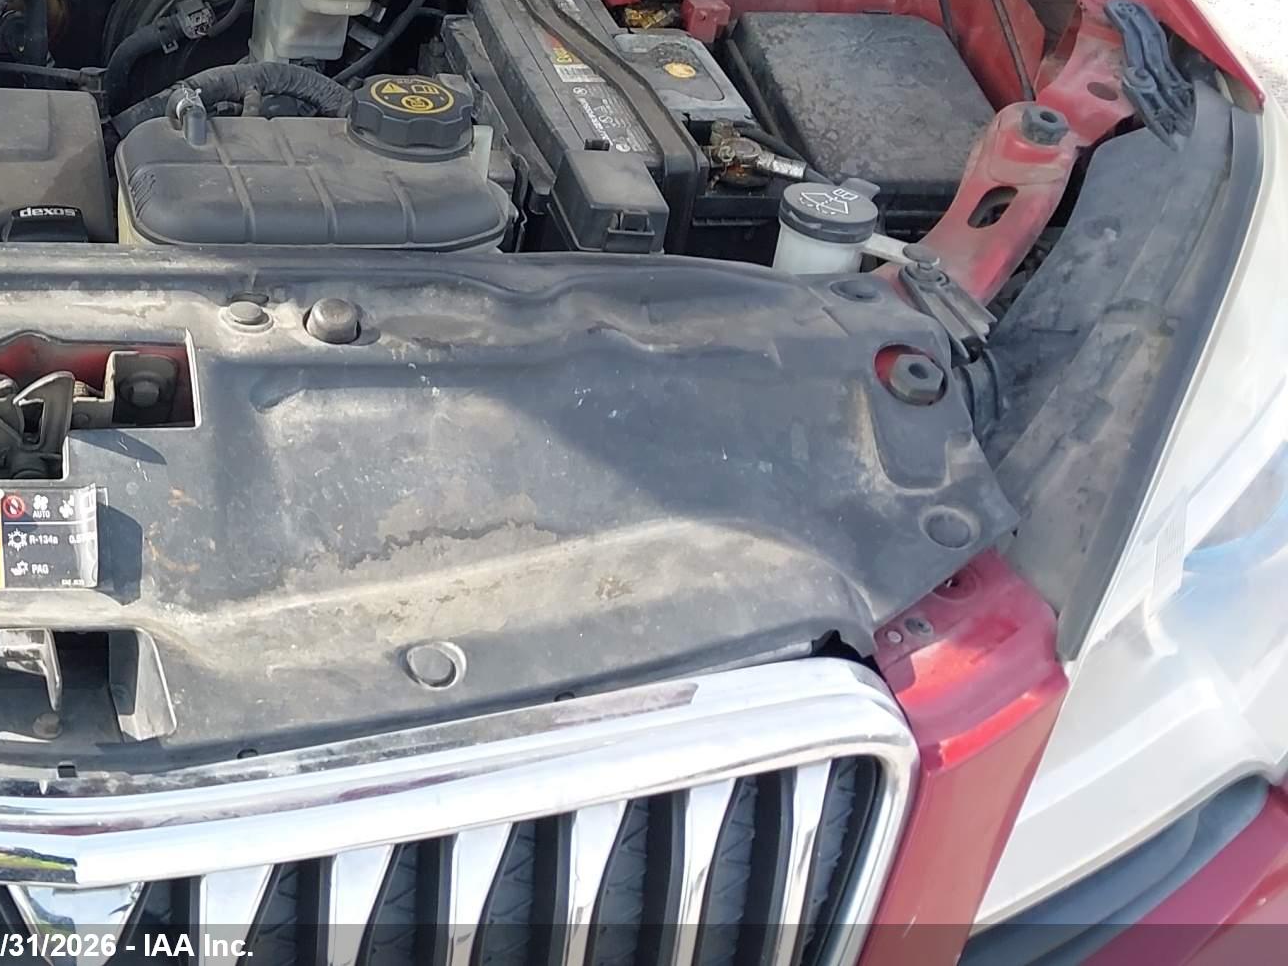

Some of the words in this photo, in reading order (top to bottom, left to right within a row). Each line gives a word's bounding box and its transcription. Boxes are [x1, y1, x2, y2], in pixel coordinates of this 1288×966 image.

[19, 207, 76, 218] dexos
[32, 510, 50, 519] AUTO
[28, 534, 59, 545] R-134a
[31, 563, 50, 575] PAG
